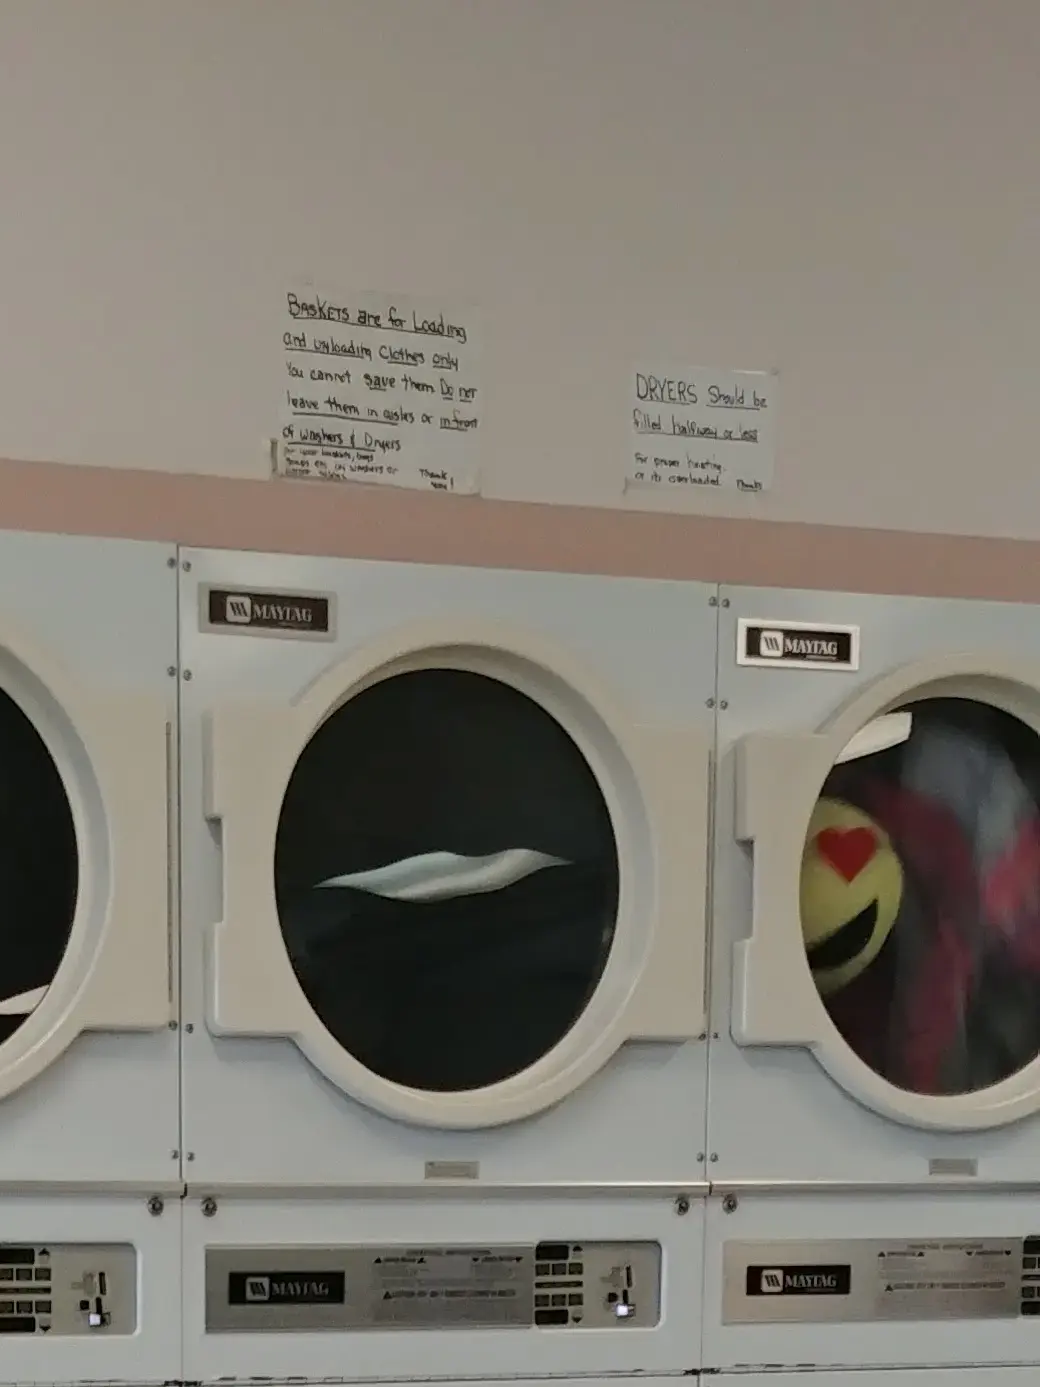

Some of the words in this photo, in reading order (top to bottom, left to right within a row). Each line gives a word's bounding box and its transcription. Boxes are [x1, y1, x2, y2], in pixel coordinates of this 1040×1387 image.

[358, 309, 381, 328] are
[388, 305, 407, 328] for
[413, 310, 467, 344] Loading
[283, 332, 306, 348] and
[432, 352, 459, 371] only
[286, 361, 304, 379] You
[310, 368, 351, 384] cannot
[363, 373, 396, 389] save
[401, 375, 435, 393] them
[636, 373, 698, 403] DRYERS
[753, 390, 767, 408] be
[287, 390, 319, 411] leave
[324, 395, 360, 416] them
[367, 406, 379, 418] in
[421, 413, 433, 425] or
[253, 604, 312, 622] MAYTAG
[784, 639, 838, 655] MAYTAG
[272, 1281, 329, 1296] MAYTAG
[785, 1274, 837, 1288] MAYTAG
